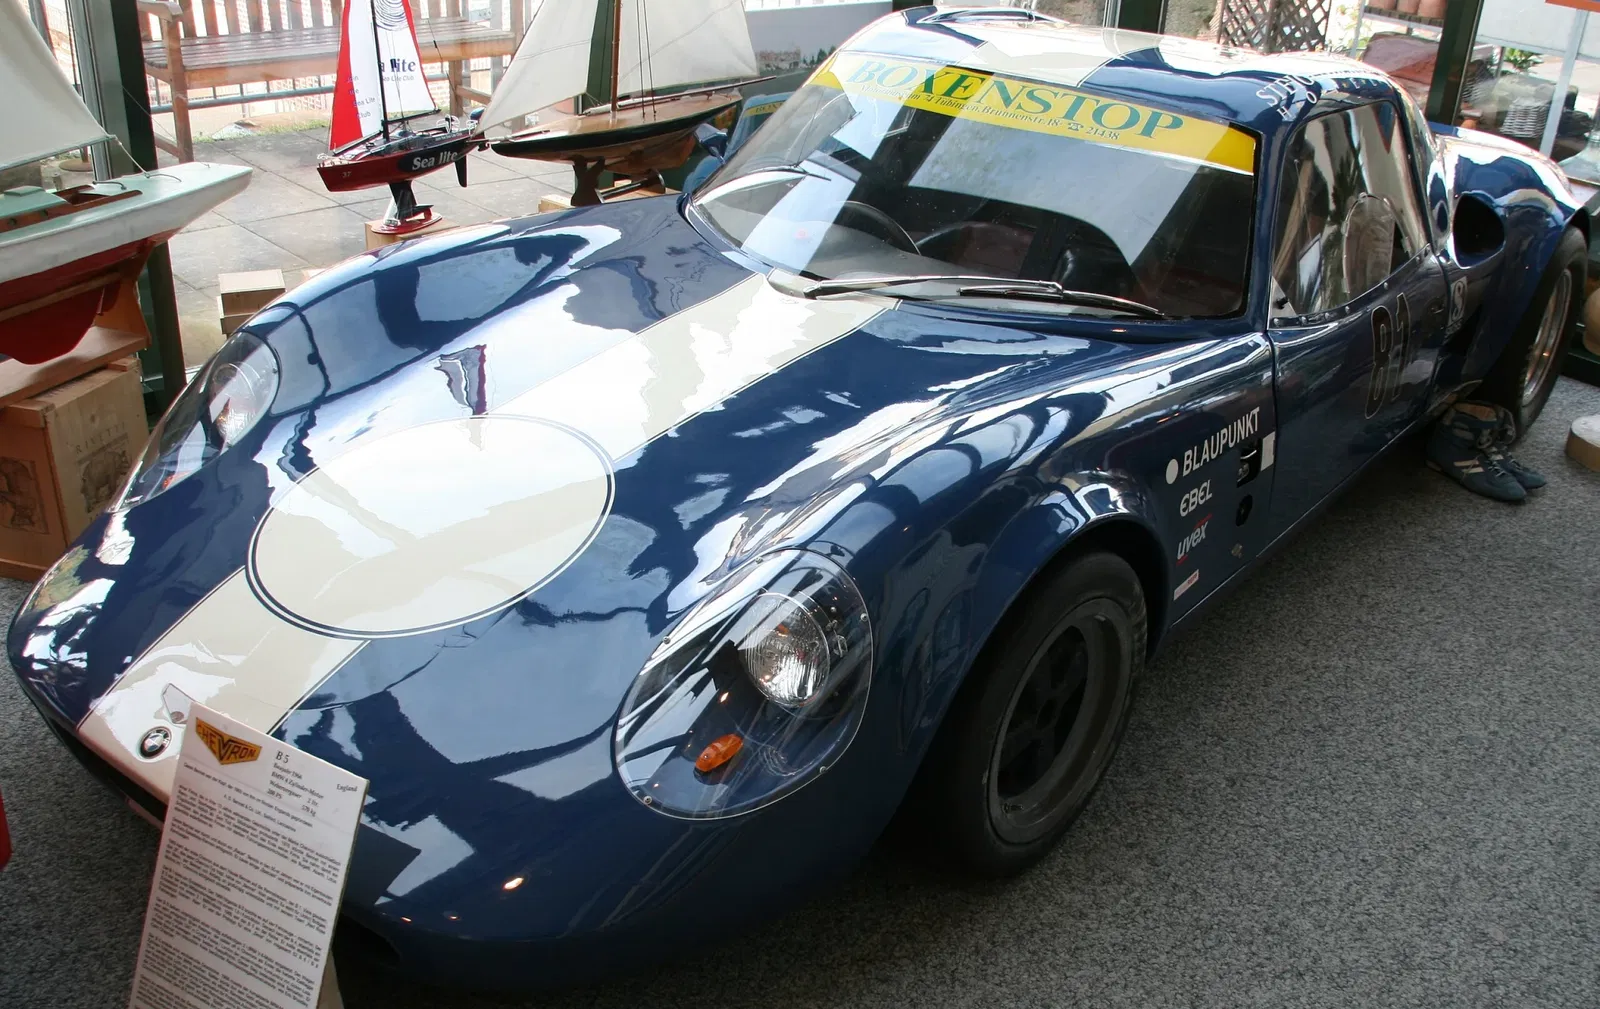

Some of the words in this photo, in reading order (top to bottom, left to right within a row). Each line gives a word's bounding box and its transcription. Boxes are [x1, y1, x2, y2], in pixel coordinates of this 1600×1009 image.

[846, 60, 1184, 139] BOXENSTOP
[412, 156, 435, 171] Sea
[438, 151, 458, 165] lite
[1364, 292, 1411, 420] 81
[1182, 406, 1260, 477] BLAUPUNKT
[1180, 479, 1213, 517] EBEL
[1177, 521, 1209, 560] uvex
[275, 750, 284, 761] B
[283, 754, 290, 764] 5
[336, 783, 358, 793] England
